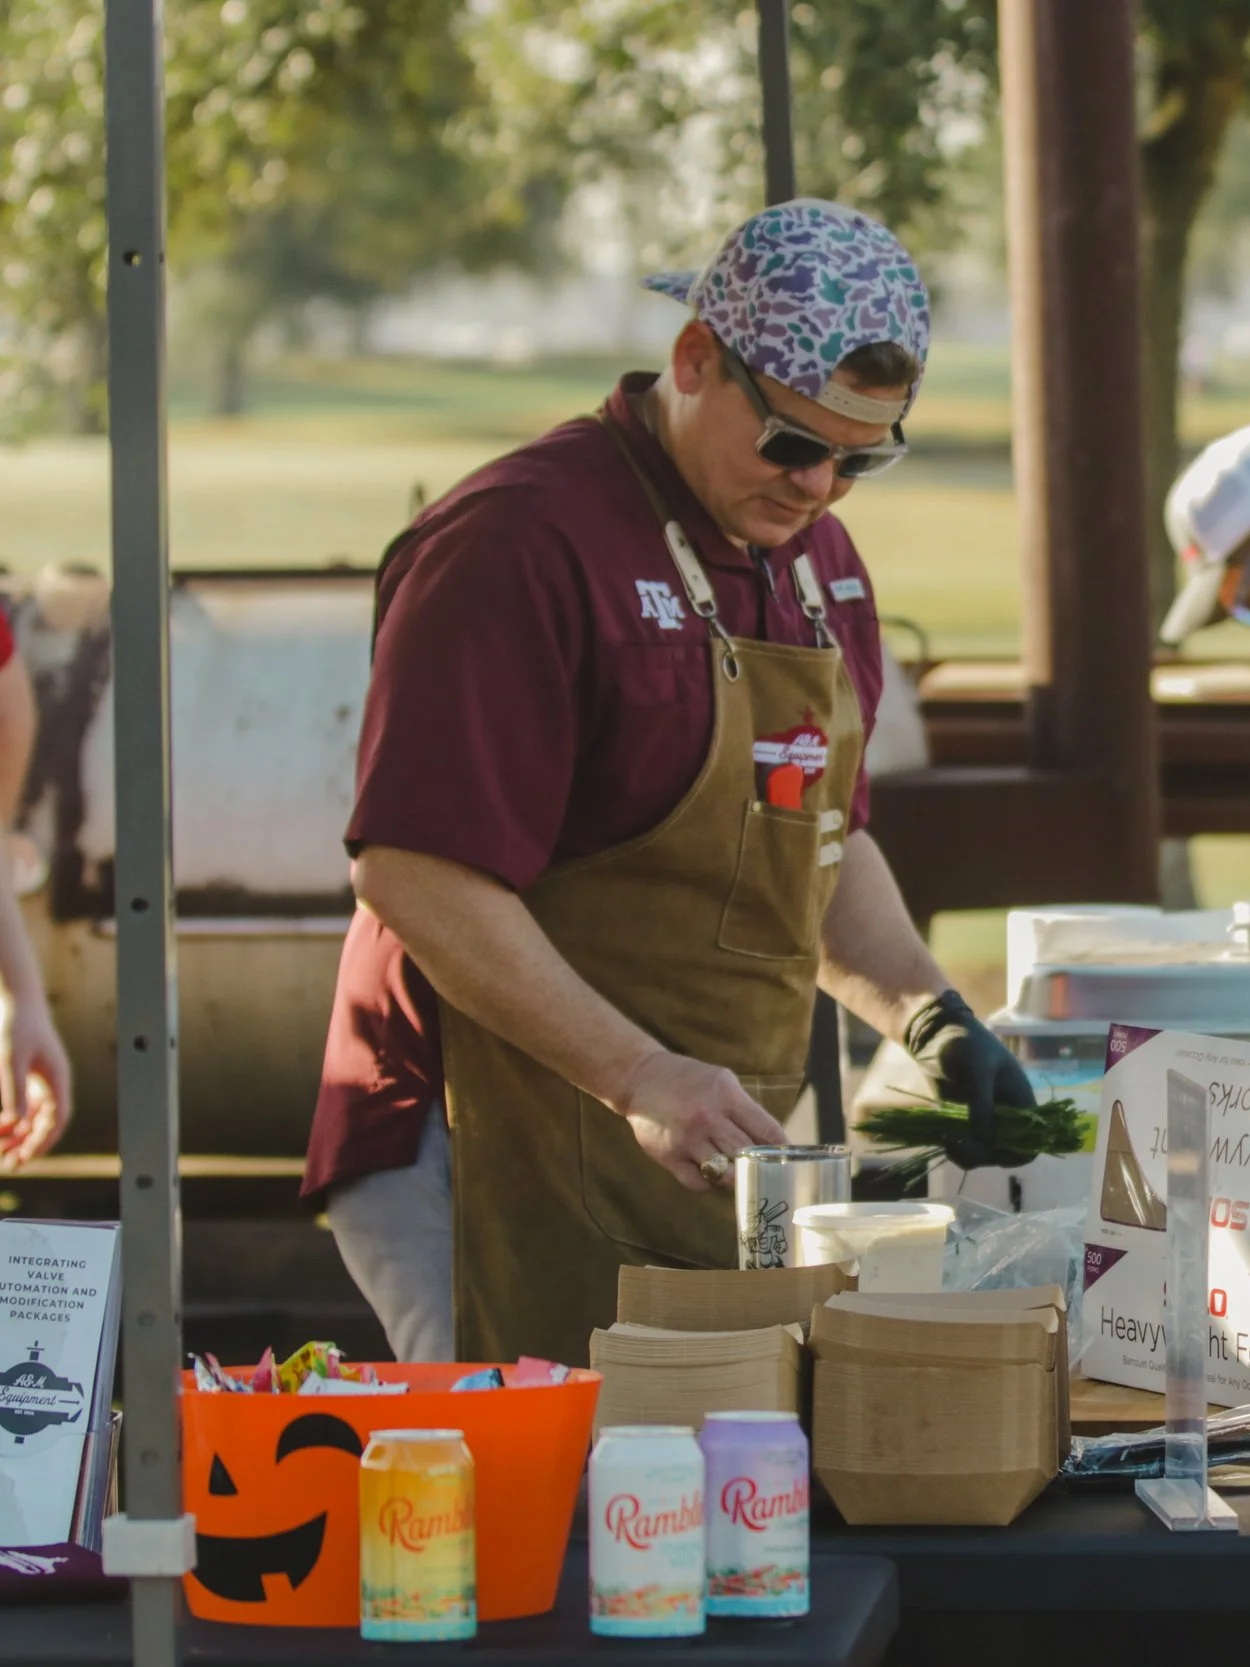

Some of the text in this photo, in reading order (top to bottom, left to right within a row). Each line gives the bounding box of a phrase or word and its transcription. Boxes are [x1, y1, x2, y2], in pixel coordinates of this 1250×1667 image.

[1110, 1039, 1128, 1053] 500
[8, 1255, 87, 1269] INTEGRATING
[1086, 1251, 1103, 1266] 500
[27, 1270, 65, 1281] VALVE
[0, 1282, 97, 1297] UTOMATION AND
[9, 1310, 71, 1323] PACKAGES
[13, 1373, 47, 1389] A&M
[0, 1385, 57, 1407] Equipment
